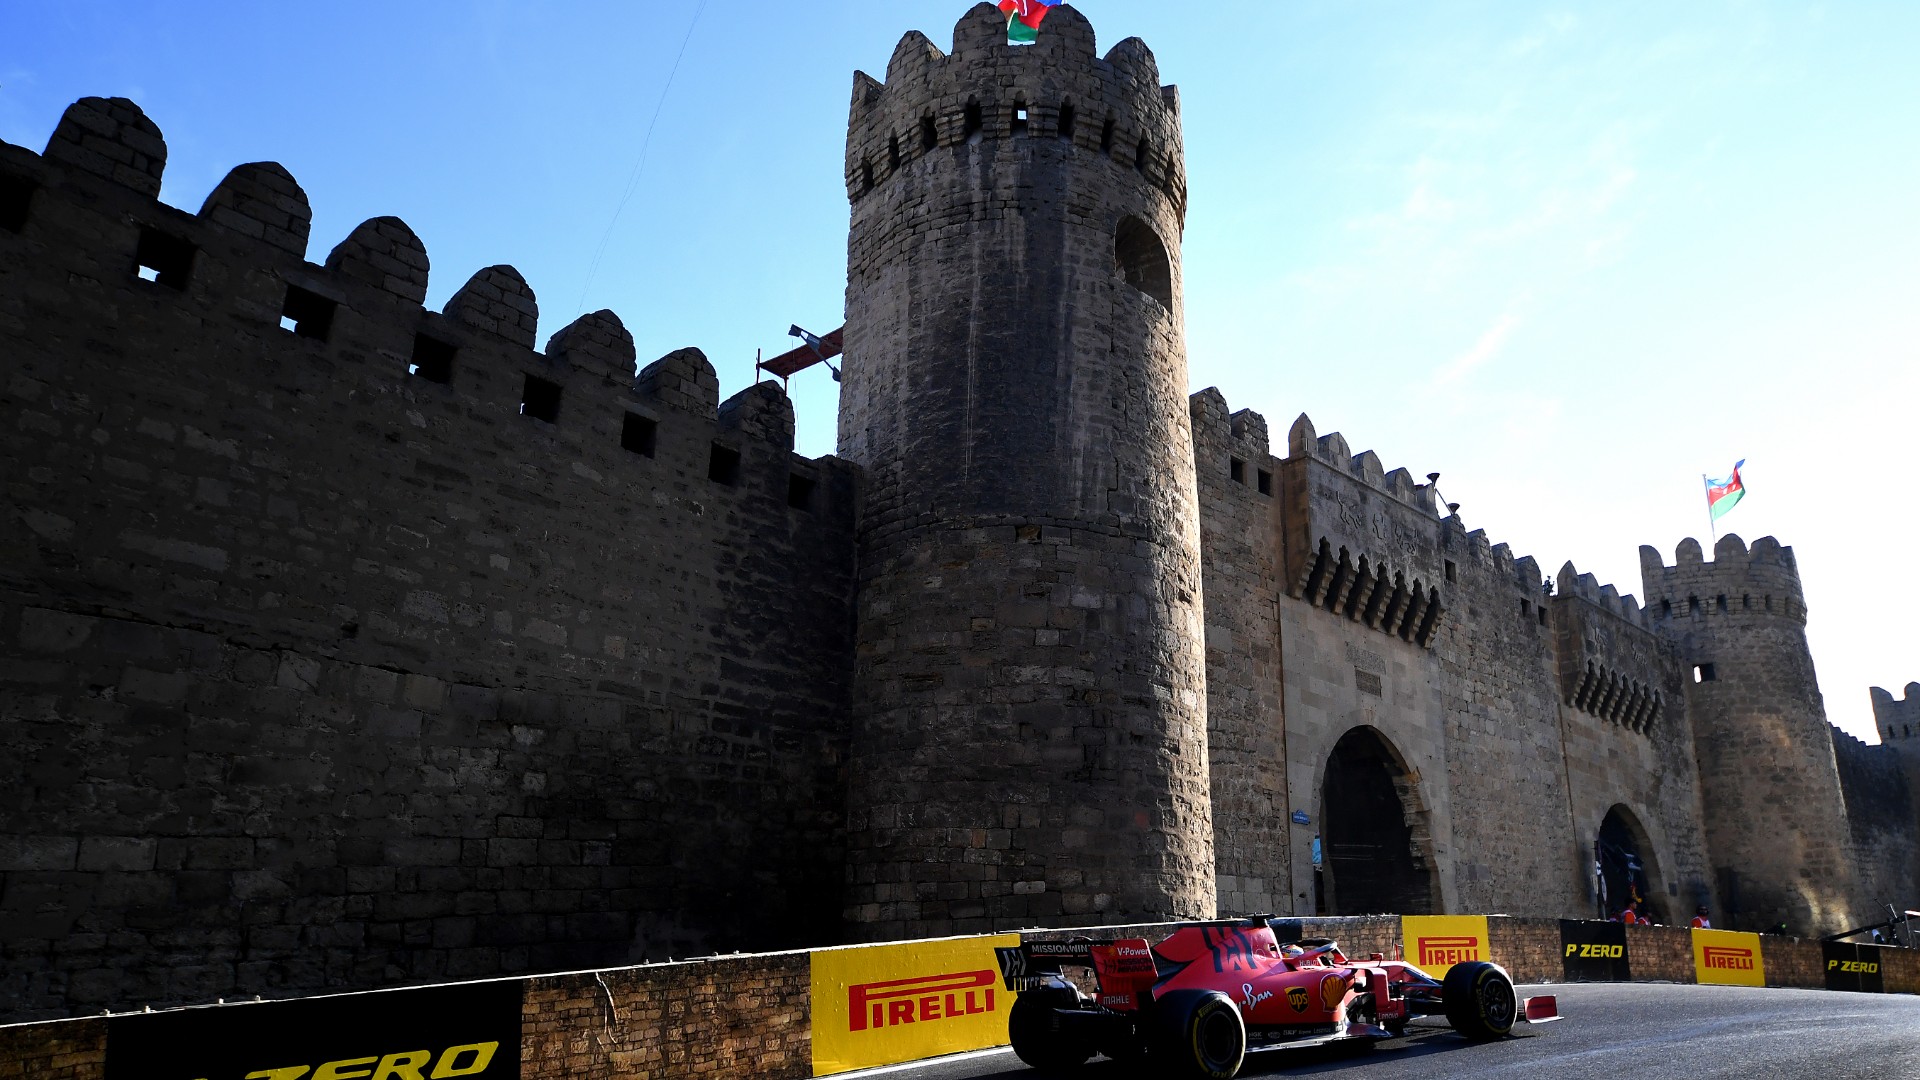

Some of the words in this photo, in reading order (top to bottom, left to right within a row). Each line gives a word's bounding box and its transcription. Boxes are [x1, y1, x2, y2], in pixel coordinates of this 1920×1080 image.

[1418, 937, 1477, 965] PIRELLI
[1566, 944, 1577, 957] P
[1580, 944, 1623, 957] ZERO
[1704, 946, 1753, 970] PIRELLI
[1828, 960, 1838, 971] P
[1841, 960, 1878, 973] ZERO
[848, 970, 996, 1032] PIRELLI
[1104, 994, 1129, 1005] MAHLE
